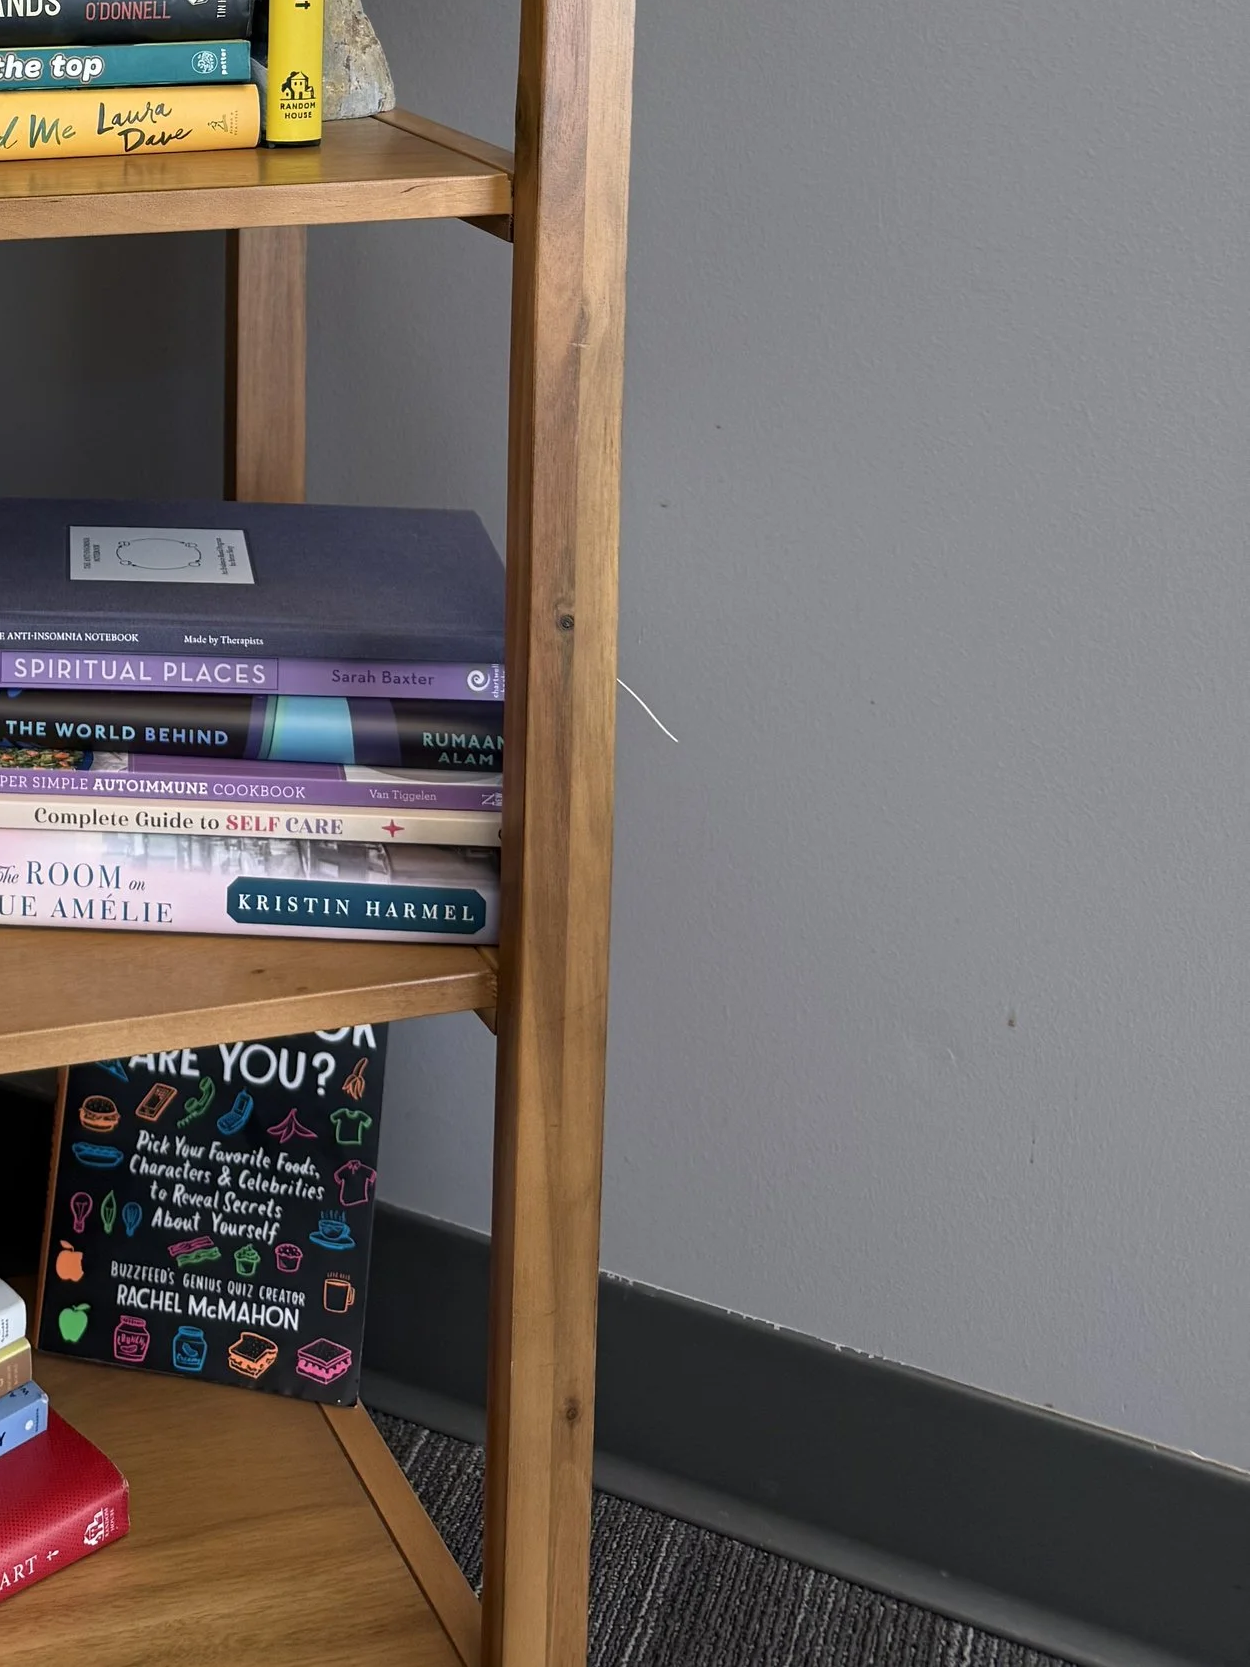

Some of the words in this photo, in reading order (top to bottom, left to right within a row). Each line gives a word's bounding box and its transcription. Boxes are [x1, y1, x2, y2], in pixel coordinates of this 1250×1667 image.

[85, 1, 171, 21] O'DONNELL
[217, 5, 226, 18] TIN
[51, 54, 104, 83] top
[97, 102, 172, 134] Laura
[285, 111, 312, 119] HOUSE
[29, 114, 76, 149] Me
[118, 127, 193, 152] Dave
[85, 633, 139, 642] NOTEBOOK
[184, 635, 206, 645] Made
[208, 636, 219, 646] by
[220, 636, 263, 647] Therapists
[15, 658, 152, 681] SPIRITUAL
[163, 662, 266, 683] PLACES
[331, 670, 376, 684] Sarah
[382, 671, 434, 685] Baxter
[6, 720, 46, 736] THE
[55, 723, 135, 740] WORLD
[146, 727, 229, 745] BEHIND
[438, 752, 493, 765] ALAM
[33, 776, 88, 790] SIMPLE
[93, 778, 208, 795] AUTOIMMUNE
[213, 783, 305, 798] COOKBOOK
[369, 789, 389, 799] Van
[392, 790, 437, 802] Tiggelen
[34, 807, 129, 828] Complete
[135, 811, 193, 829] Guide
[201, 814, 219, 830] to
[226, 815, 280, 832] SELF
[286, 817, 343, 834] CARE
[26, 860, 121, 889] ROOM
[129, 879, 146, 890] on
[51, 894, 173, 923] AMÉLIE
[238, 893, 349, 916] KRISTIN
[366, 900, 474, 921] HARMEL
[219, 1041, 336, 1096] YOU?
[136, 1130, 168, 1157] Pick
[175, 1135, 205, 1158] Your
[208, 1141, 271, 1170] Favorite
[276, 1152, 321, 1180] Foods,
[130, 1155, 210, 1184] Characters
[217, 1168, 232, 1187] &
[239, 1171, 325, 1201] Celebrities
[150, 1180, 168, 1201] to
[172, 1183, 219, 1212] Reveal
[223, 1191, 283, 1219] Secrets
[151, 1207, 200, 1232] About
[212, 1215, 280, 1246] Yourself
[110, 1260, 175, 1287] BUZZFEED'S
[183, 1272, 222, 1294] GENIUS
[227, 1280, 253, 1299] QUIZ
[259, 1285, 305, 1307] CREATOR
[116, 1284, 183, 1314] RACHEL
[188, 1297, 299, 1331] McMAHON
